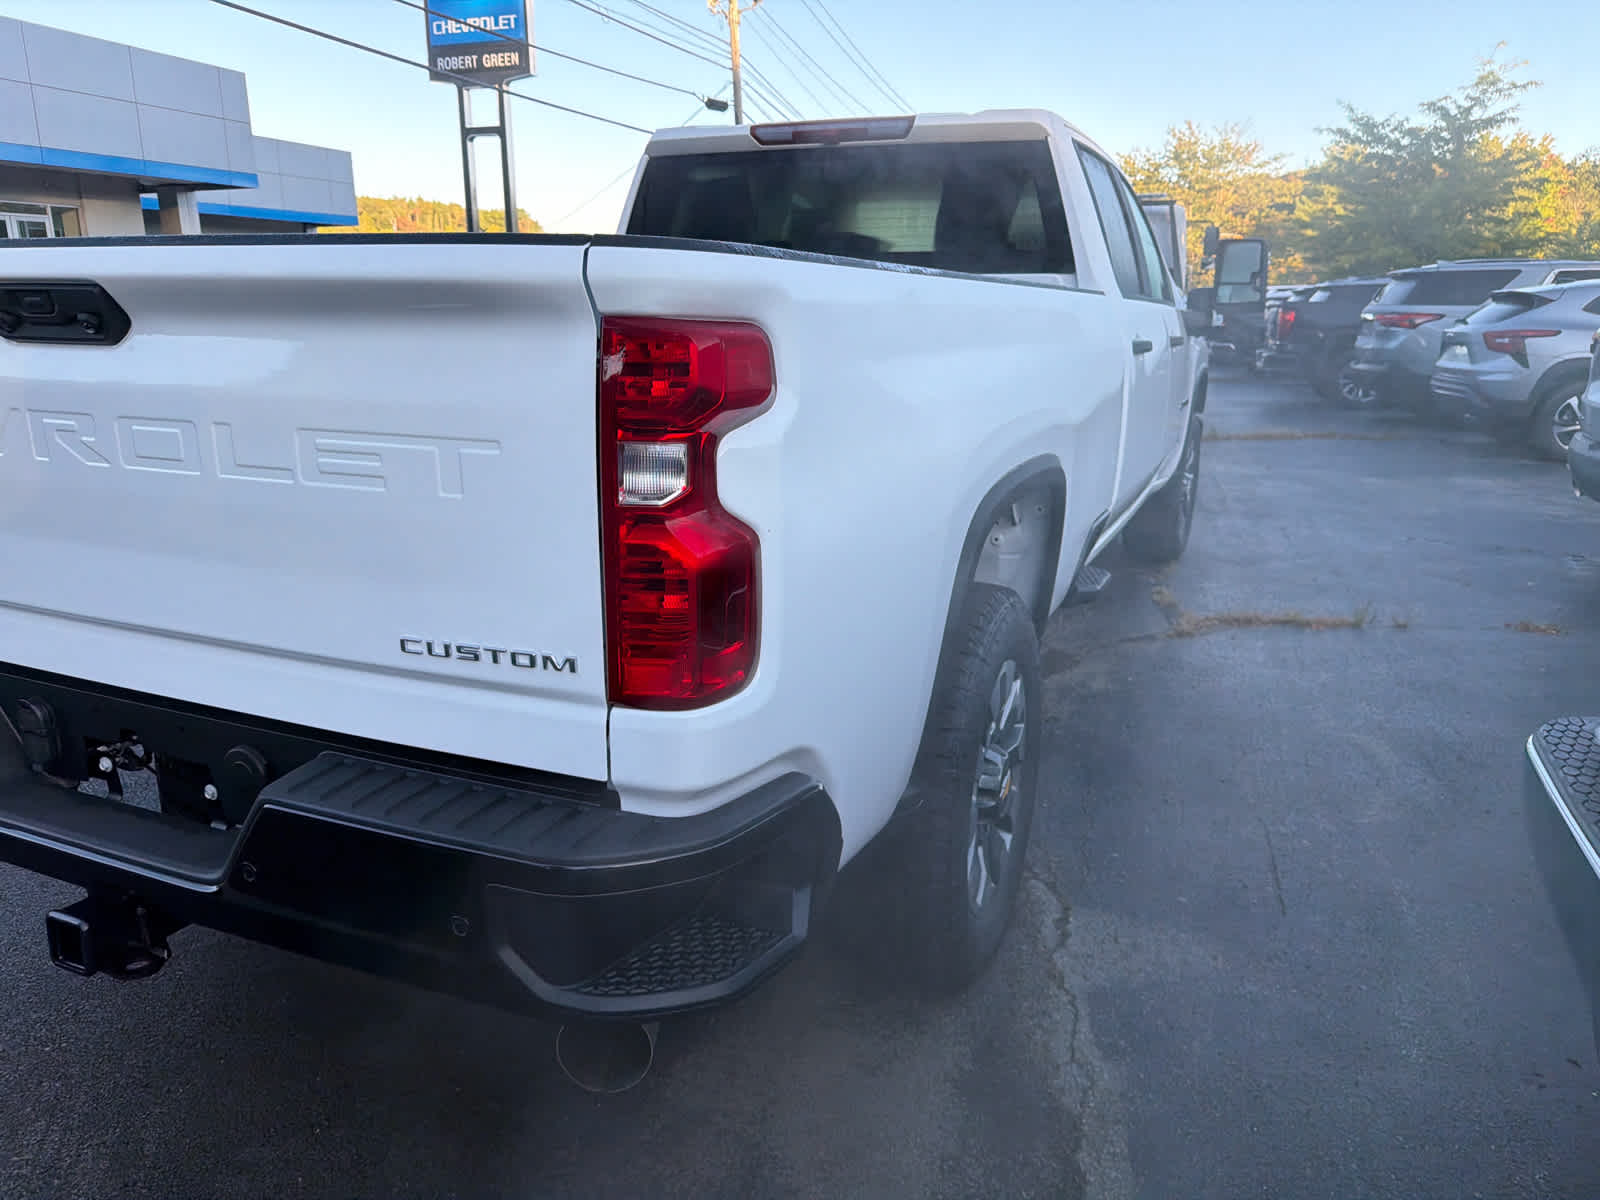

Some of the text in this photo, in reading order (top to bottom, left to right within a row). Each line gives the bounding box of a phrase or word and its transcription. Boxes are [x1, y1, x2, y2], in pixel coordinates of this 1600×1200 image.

[432, 14, 517, 35] CHEVROLET
[437, 51, 519, 71] ROBERT GREEN
[399, 634, 578, 674] CUSTOM
